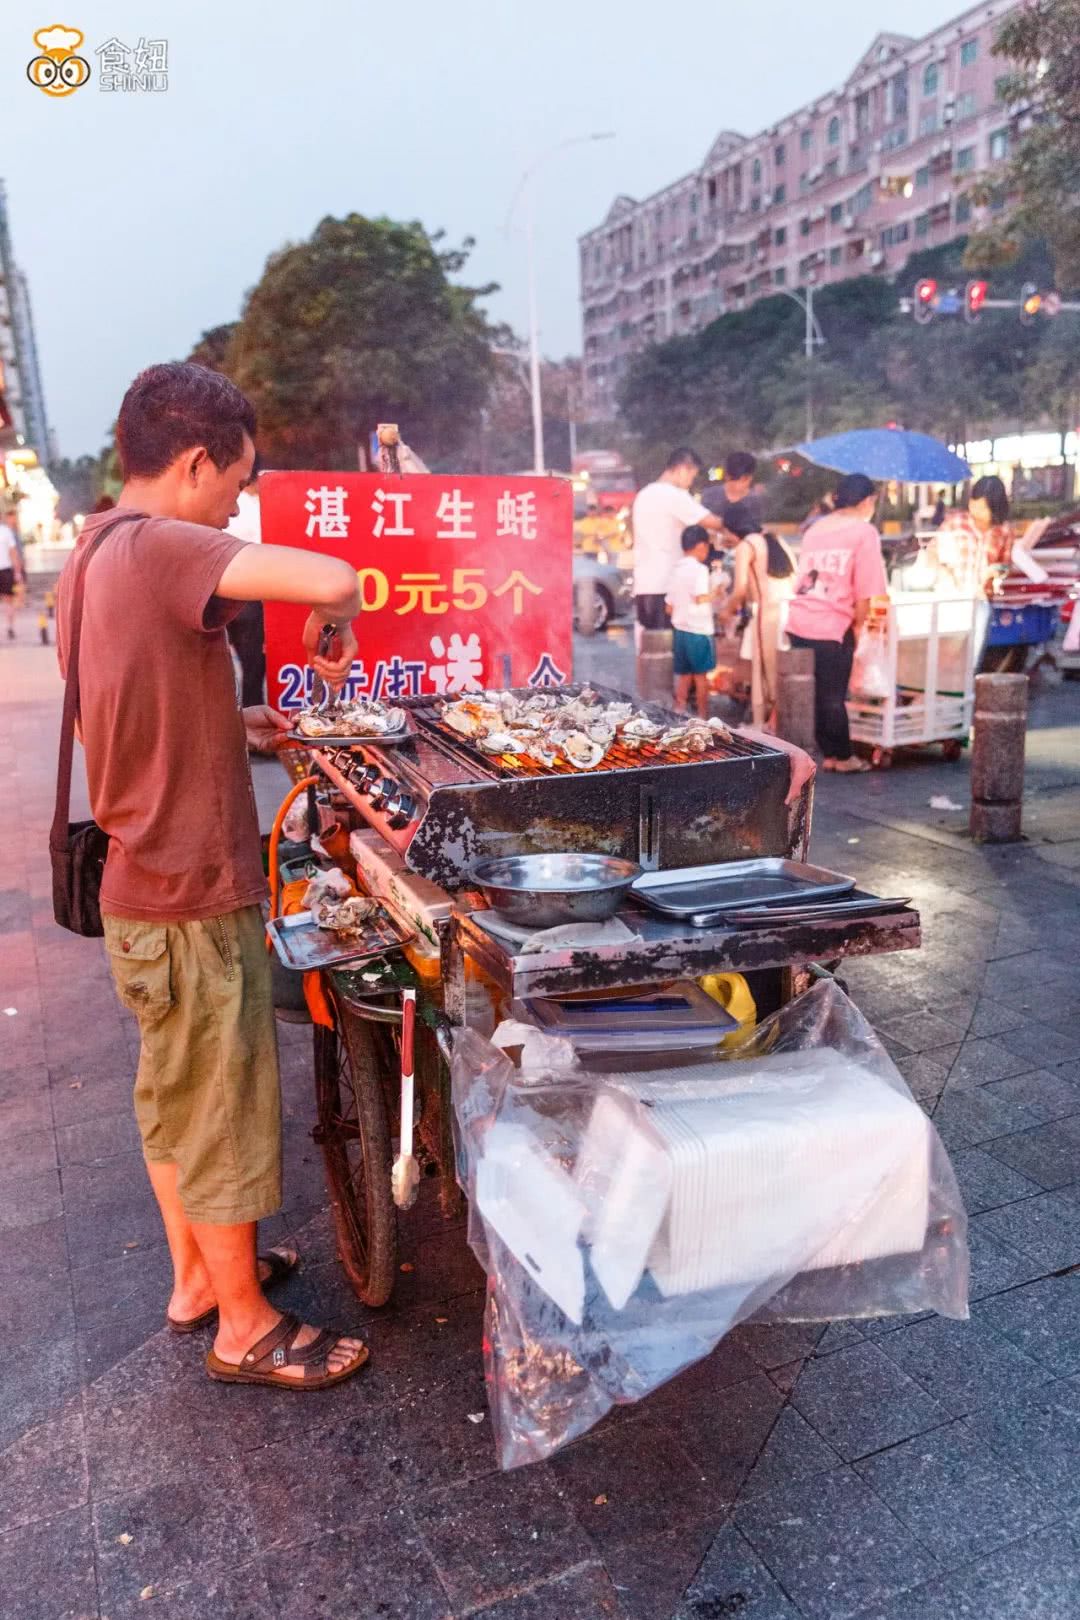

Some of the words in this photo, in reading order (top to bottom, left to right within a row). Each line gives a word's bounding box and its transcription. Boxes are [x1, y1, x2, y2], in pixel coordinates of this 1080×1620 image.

[304, 486, 538, 540] 湛江生蚝
[356, 567, 545, 616] 0元5个
